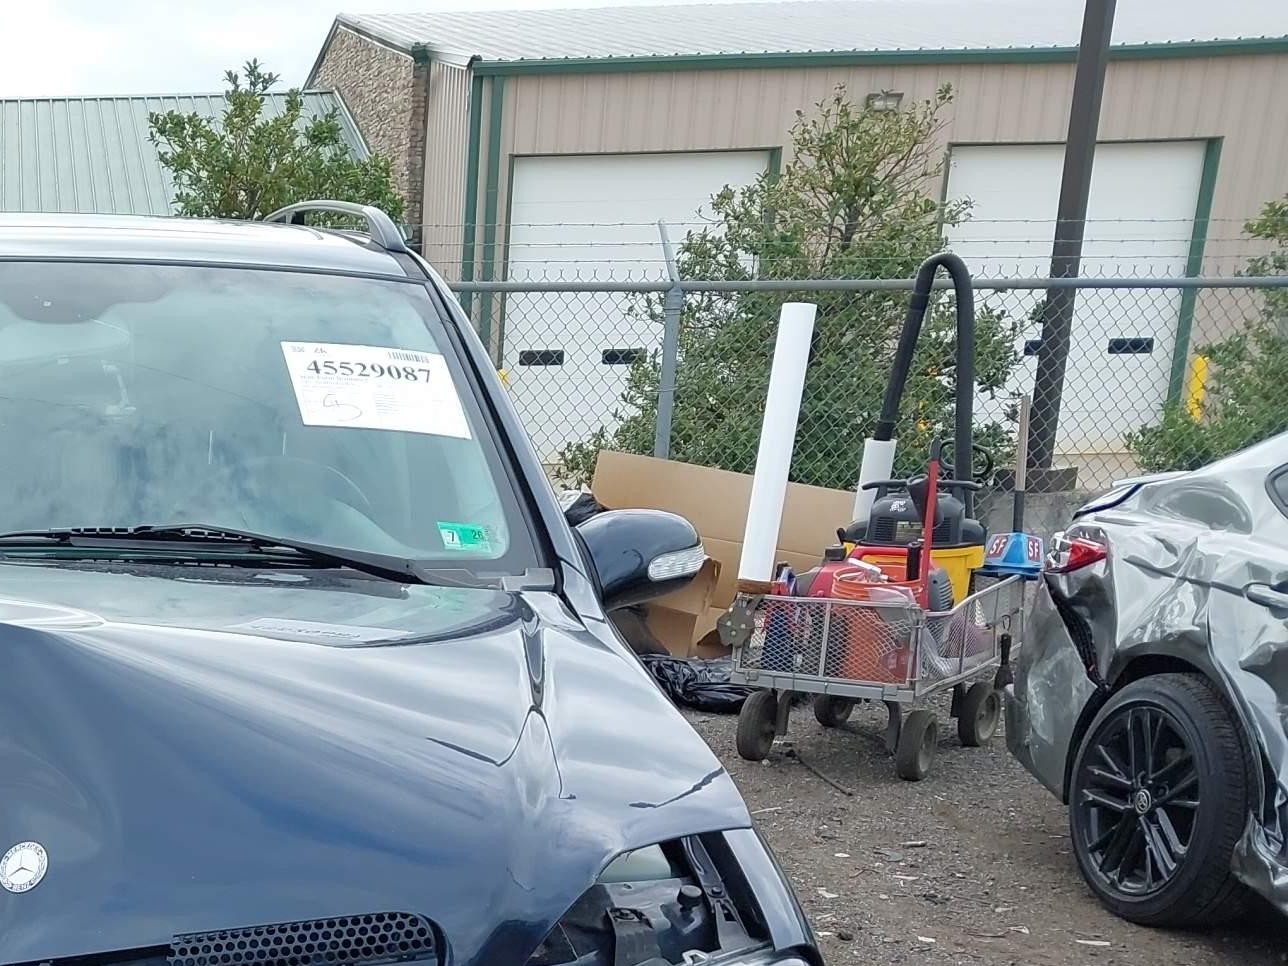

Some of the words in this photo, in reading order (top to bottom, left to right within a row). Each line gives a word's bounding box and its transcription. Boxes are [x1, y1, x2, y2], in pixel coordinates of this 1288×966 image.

[306, 359, 431, 384] 45529087
[989, 538, 1007, 554] SF
[1028, 540, 1039, 557] SF
